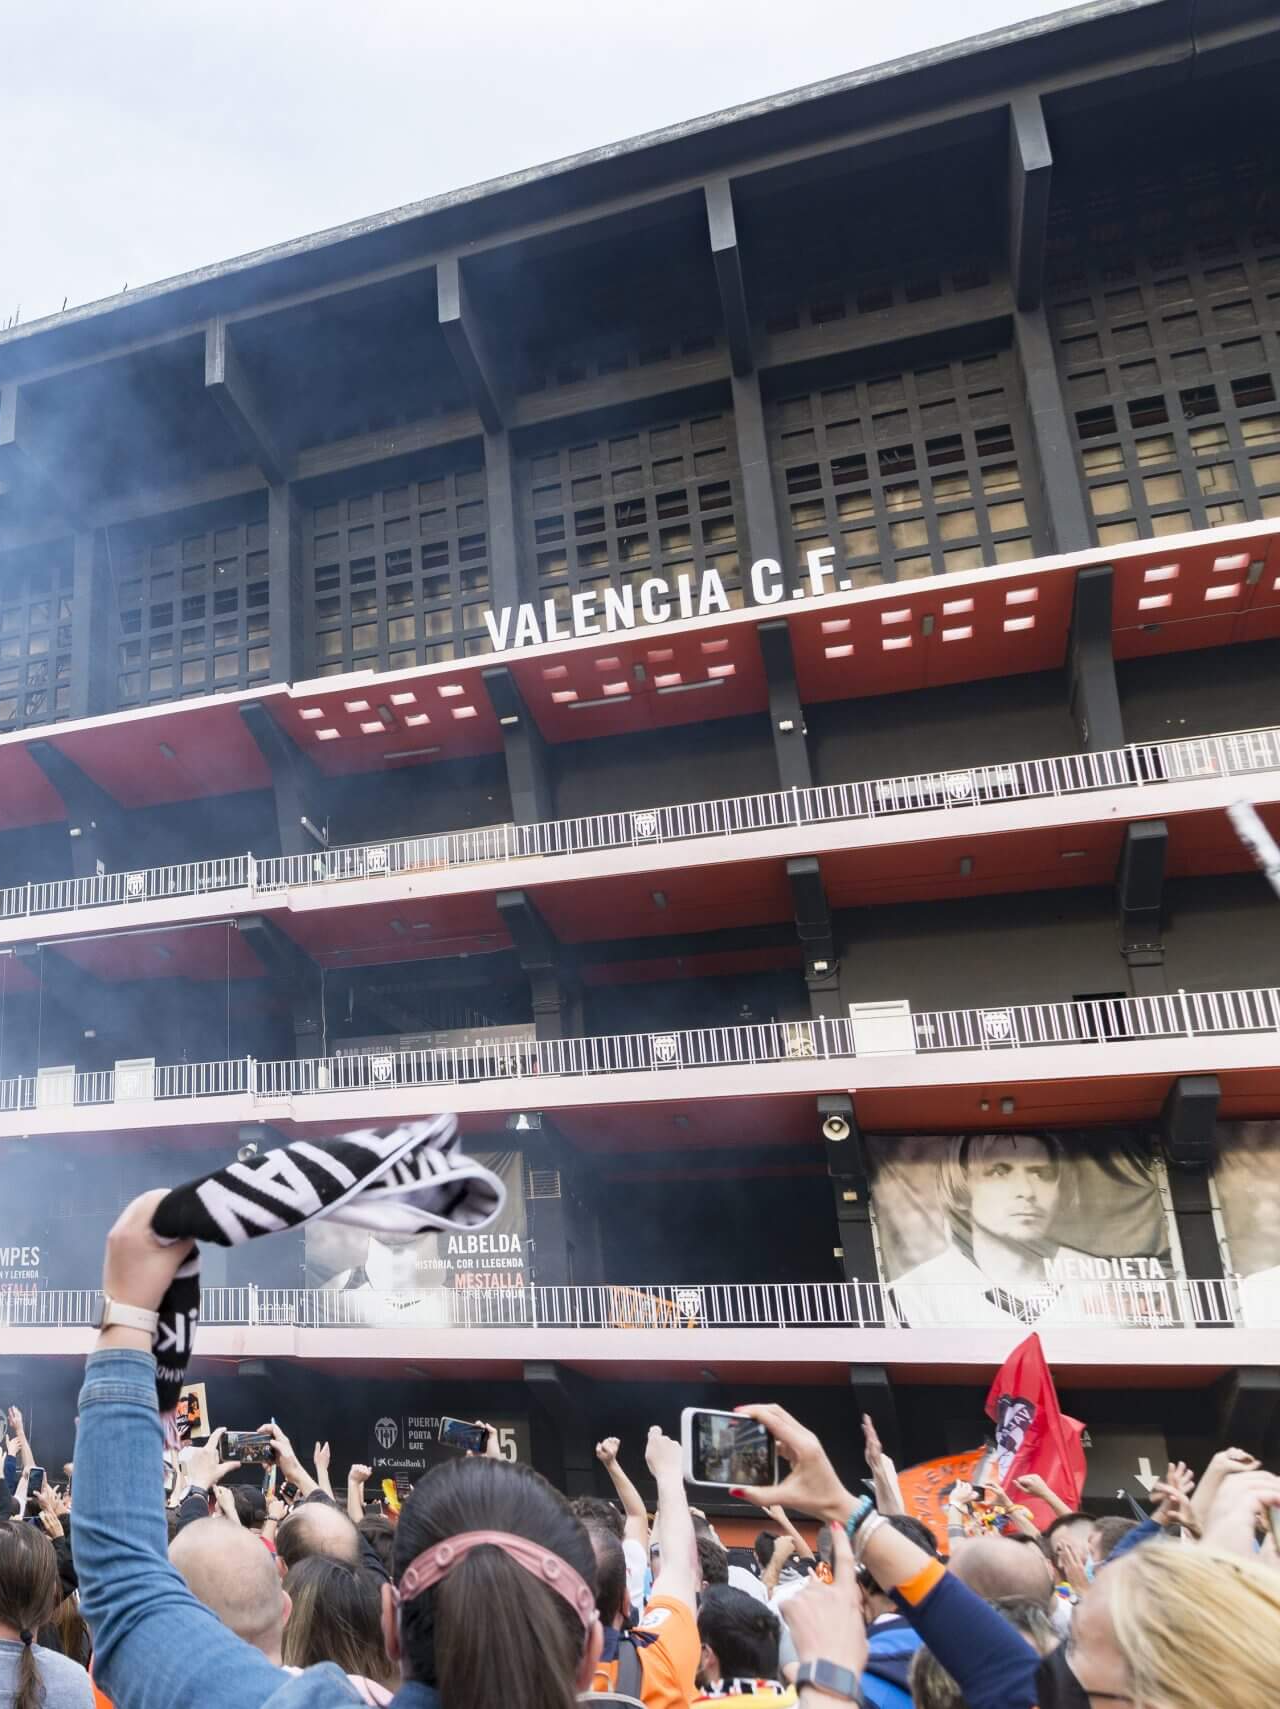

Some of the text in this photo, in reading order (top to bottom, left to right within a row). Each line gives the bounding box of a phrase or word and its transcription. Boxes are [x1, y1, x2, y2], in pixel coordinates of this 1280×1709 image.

[483, 547, 853, 652] VALENCIA C.F.
[447, 1234, 521, 1254] ALBELDA
[456, 1259, 474, 1269] COR
[481, 1258, 524, 1269] LLEGENDA
[1043, 1257, 1167, 1280] MENDIETA
[10, 1270, 39, 1280] LEYENDA
[455, 1273, 524, 1290] MESTALLA
[408, 1417, 440, 1428] PUERTA
[408, 1431, 432, 1440] PORTA
[408, 1442, 424, 1450] GATE
[387, 1458, 422, 1468] CaixaBank
